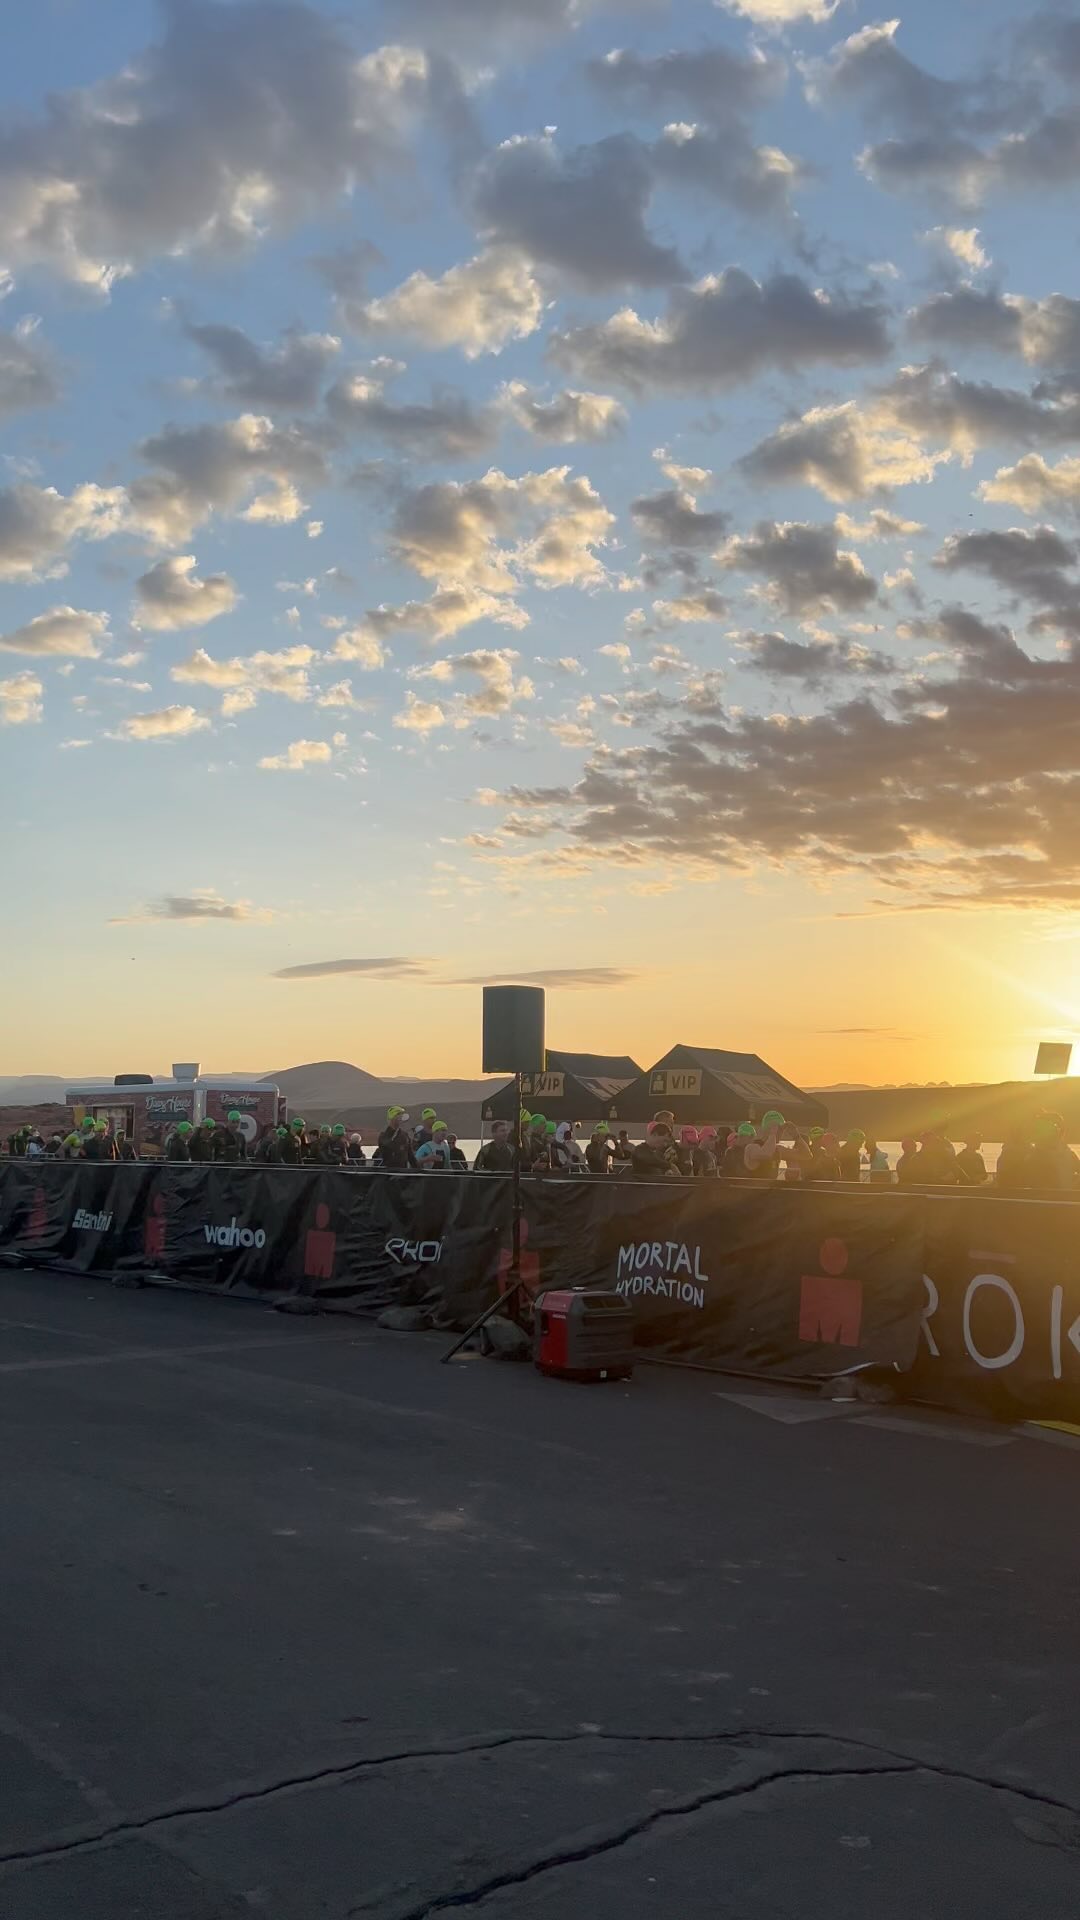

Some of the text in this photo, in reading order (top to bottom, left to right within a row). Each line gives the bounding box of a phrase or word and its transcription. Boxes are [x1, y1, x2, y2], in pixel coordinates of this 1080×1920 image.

[540, 1077, 560, 1090] VIP
[671, 1076, 697, 1089] VIP
[204, 1216, 266, 1248] wahoo
[616, 1241, 709, 1282] MORTAL
[615, 1275, 705, 1309] HYDRATION
